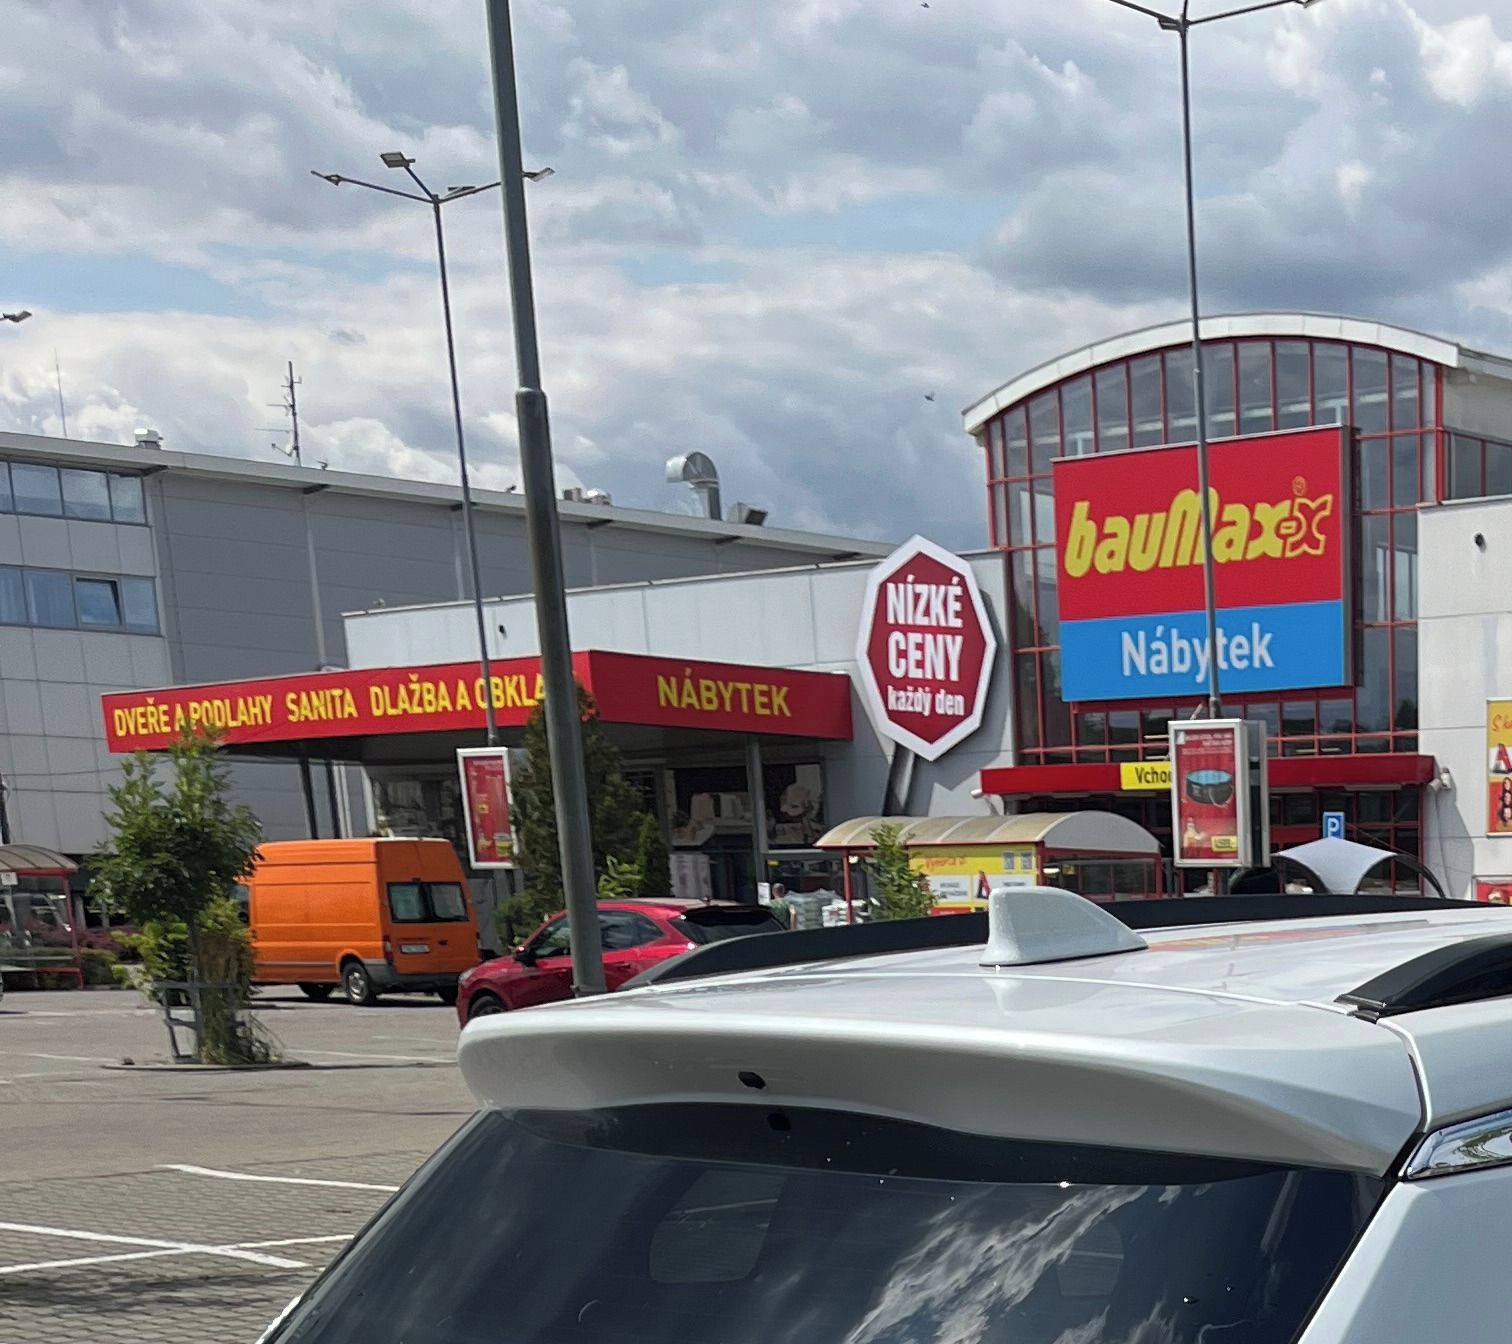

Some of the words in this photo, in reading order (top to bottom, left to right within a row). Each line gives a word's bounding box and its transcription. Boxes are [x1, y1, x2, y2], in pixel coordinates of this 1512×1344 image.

[886, 574, 964, 628] NÍZKÉ
[887, 631, 964, 682] CENY
[1121, 621, 1275, 683] Nábytek
[113, 696, 172, 737] DVEŘE
[174, 703, 186, 732] A
[189, 694, 273, 731] PODLAHY
[285, 687, 359, 722] SANITA
[368, 672, 453, 717] DLAŽBA
[455, 679, 473, 711] A
[656, 667, 792, 717] NÁBYTEK
[887, 685, 931, 717] každý
[935, 689, 965, 717] den
[1327, 817, 1340, 838] P
